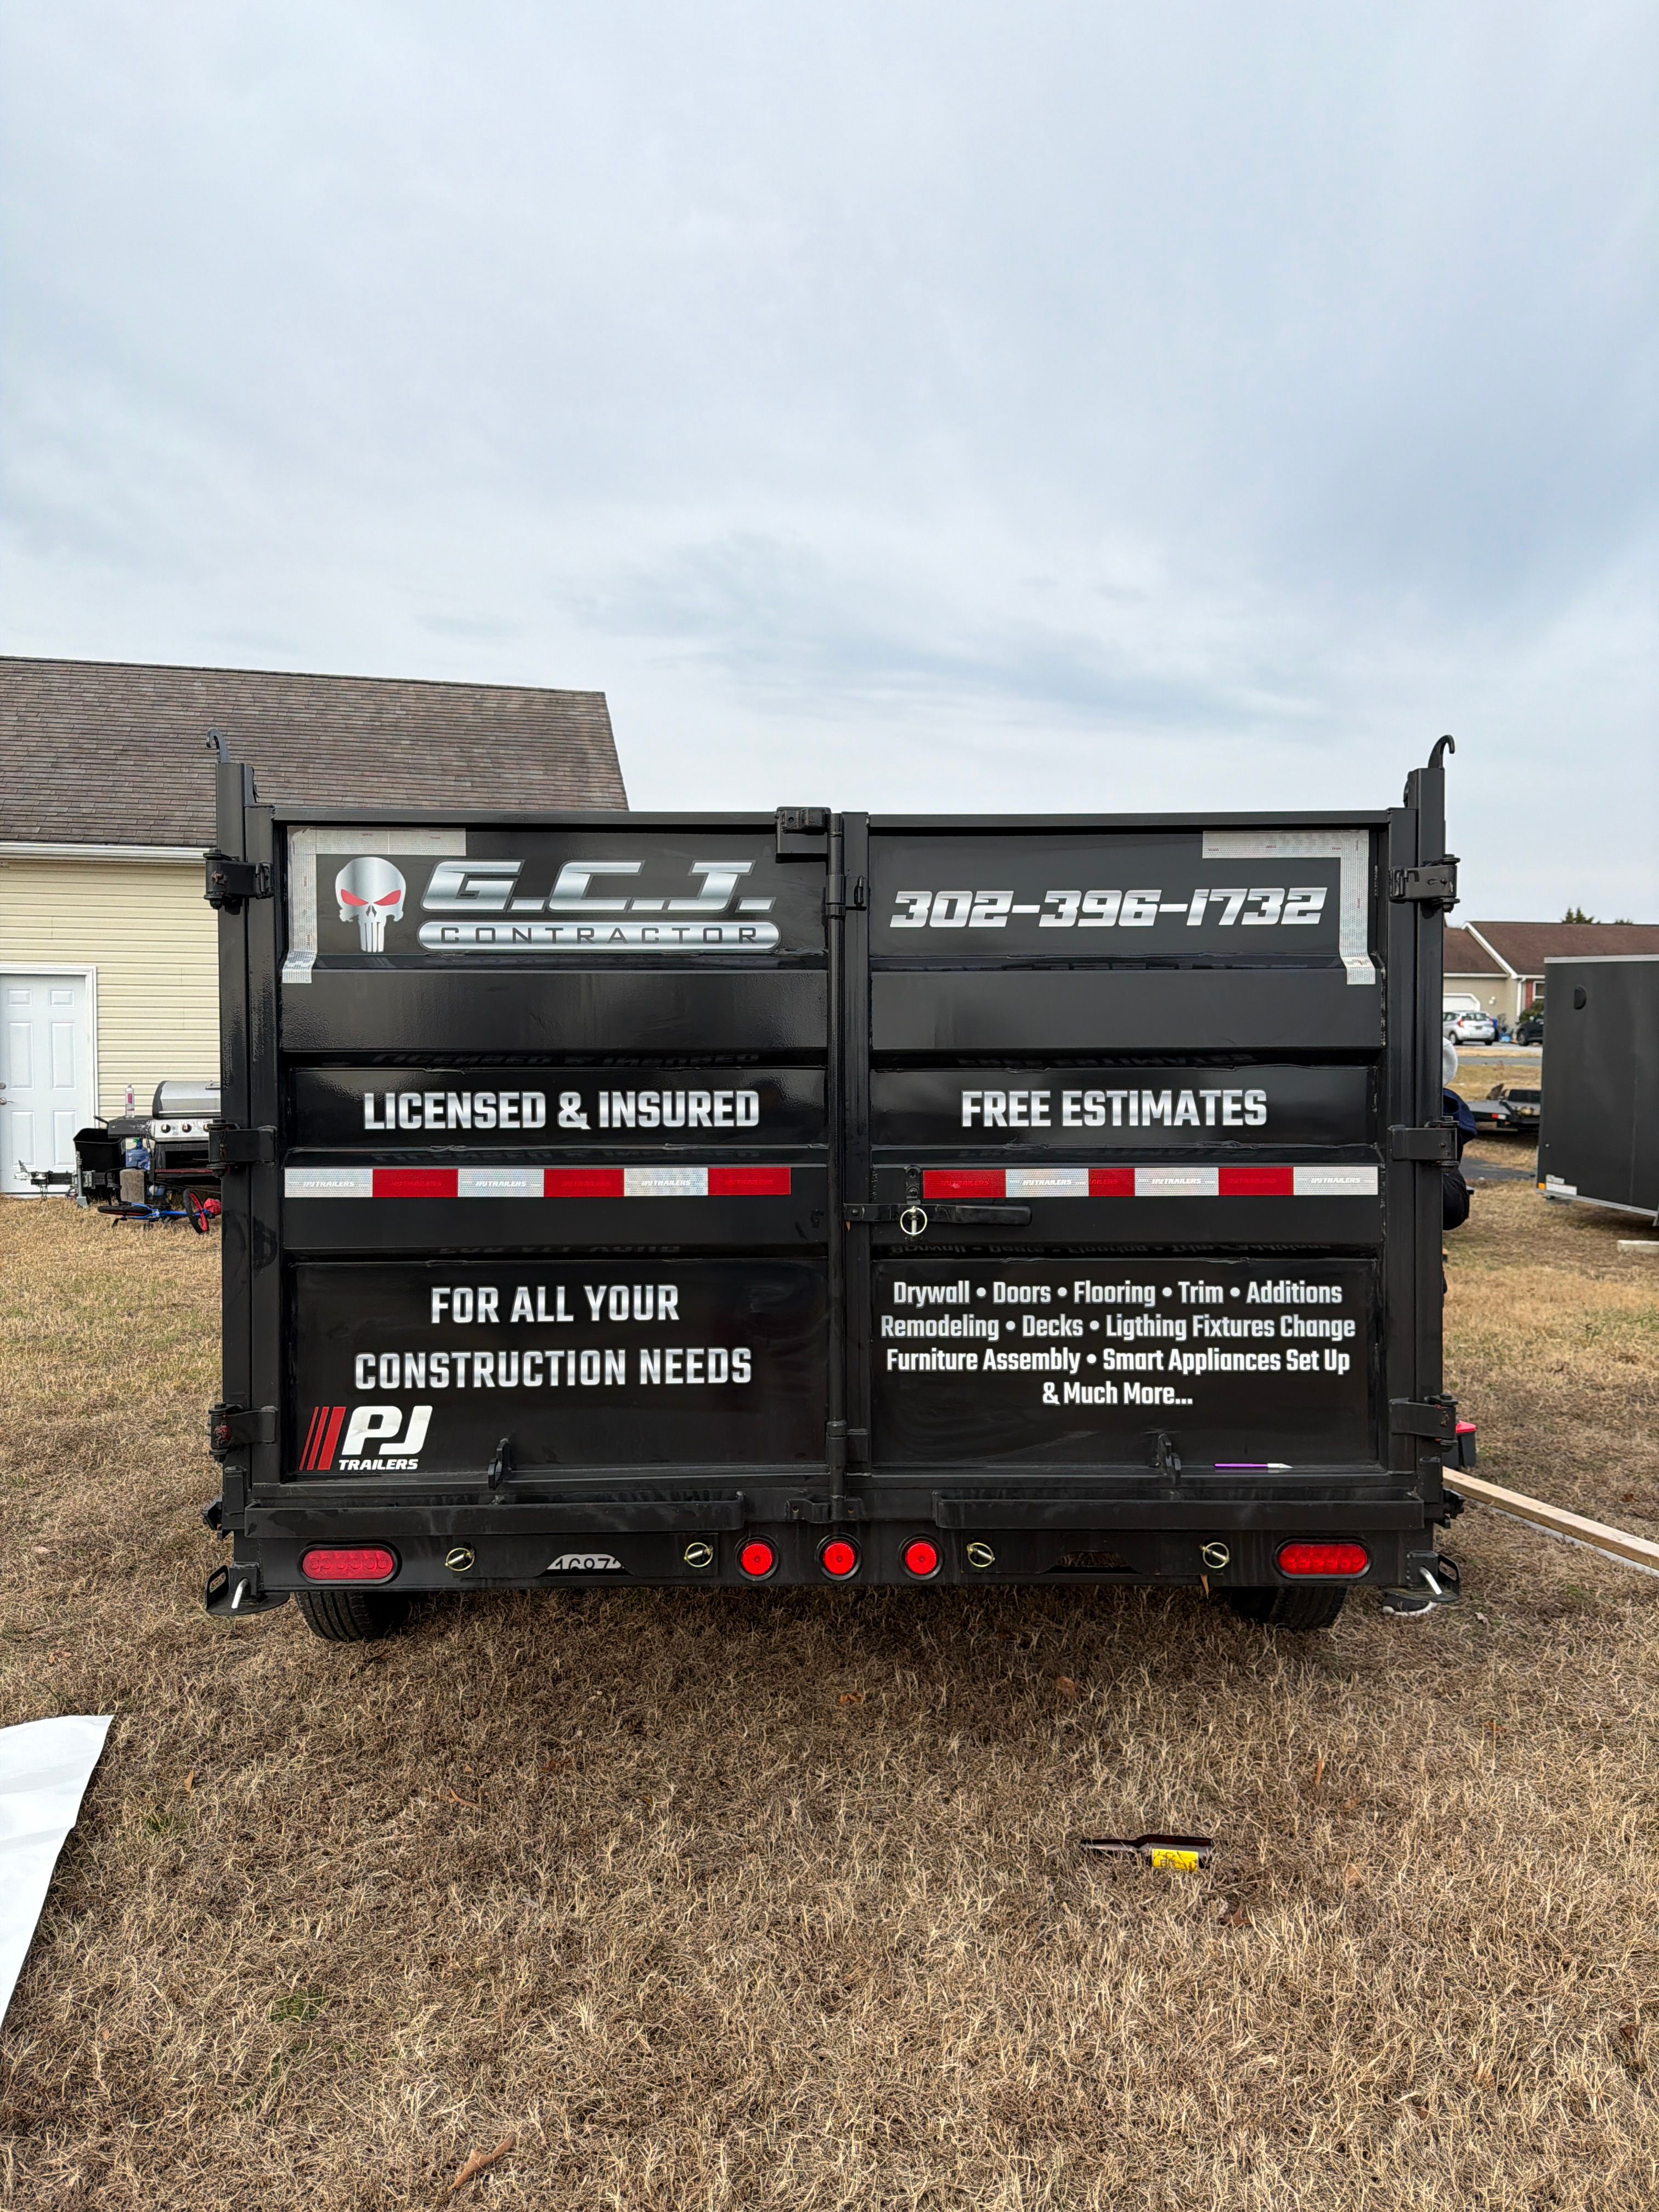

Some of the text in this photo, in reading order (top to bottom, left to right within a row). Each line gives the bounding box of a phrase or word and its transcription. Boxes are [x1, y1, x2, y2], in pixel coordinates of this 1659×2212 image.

[890, 887, 1328, 928] 302-396-1732
[440, 927, 758, 944] CONTRACTOR
[363, 1091, 759, 1130] LICENSED & INSURED
[961, 1088, 1267, 1127] FREE ESTIMATES
[431, 1285, 680, 1324] FOR ALL YOUR
[894, 1280, 1342, 1308] Drywall Doors Flooring Trim Additions
[881, 1313, 1356, 1342] Remodeling Decks Ligthing Fixtures Change
[355, 1347, 751, 1390] CONSTRUCTION NEEDS
[887, 1347, 1350, 1375] Furniture Assembly Smart Appliances Set Up
[1042, 1380, 1193, 1405] & Much More...
[341, 1405, 433, 1455] PJ
[338, 1459, 419, 1470] TRAILERS
